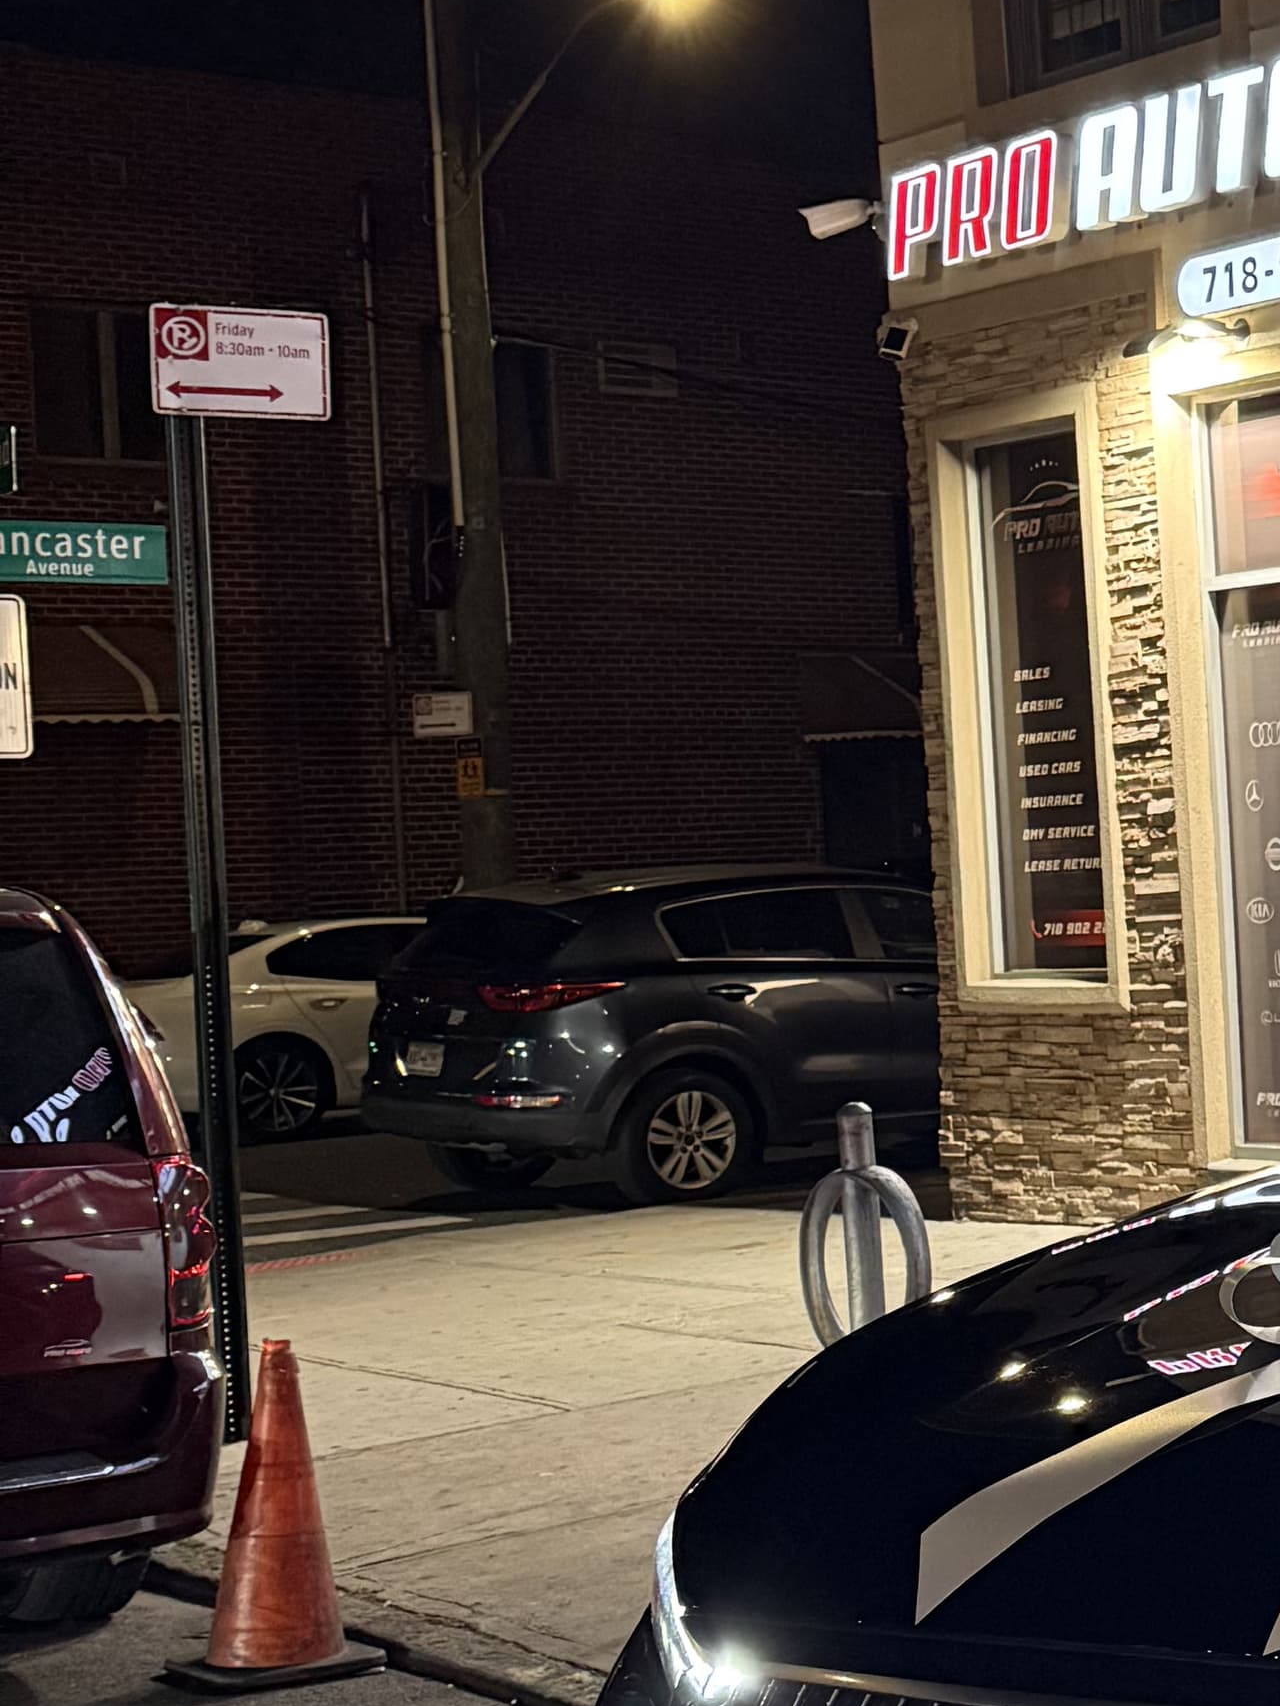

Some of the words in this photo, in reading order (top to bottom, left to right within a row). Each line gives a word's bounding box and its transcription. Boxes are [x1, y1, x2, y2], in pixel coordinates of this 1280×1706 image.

[889, 129, 1058, 281] PRO
[215, 322, 255, 339] Friday
[215, 342, 265, 357] 8:30am
[277, 345, 310, 359] 10am
[0, 528, 146, 559] ncaster
[26, 559, 94, 576] Avenue
[1014, 667, 1050, 682] SALES
[1016, 698, 1064, 714] LEASING
[1017, 728, 1077, 746] FINANCING
[1019, 764, 1048, 777] USED
[1051, 761, 1081, 775] CARS
[1021, 793, 1084, 809] INSURANCE
[1023, 828, 1045, 841] DMV
[1048, 825, 1096, 839] SERVICE
[1024, 860, 1061, 873] LEASE
[1064, 857, 1102, 870] RETUR
[1067, 922, 1090, 935] 902
